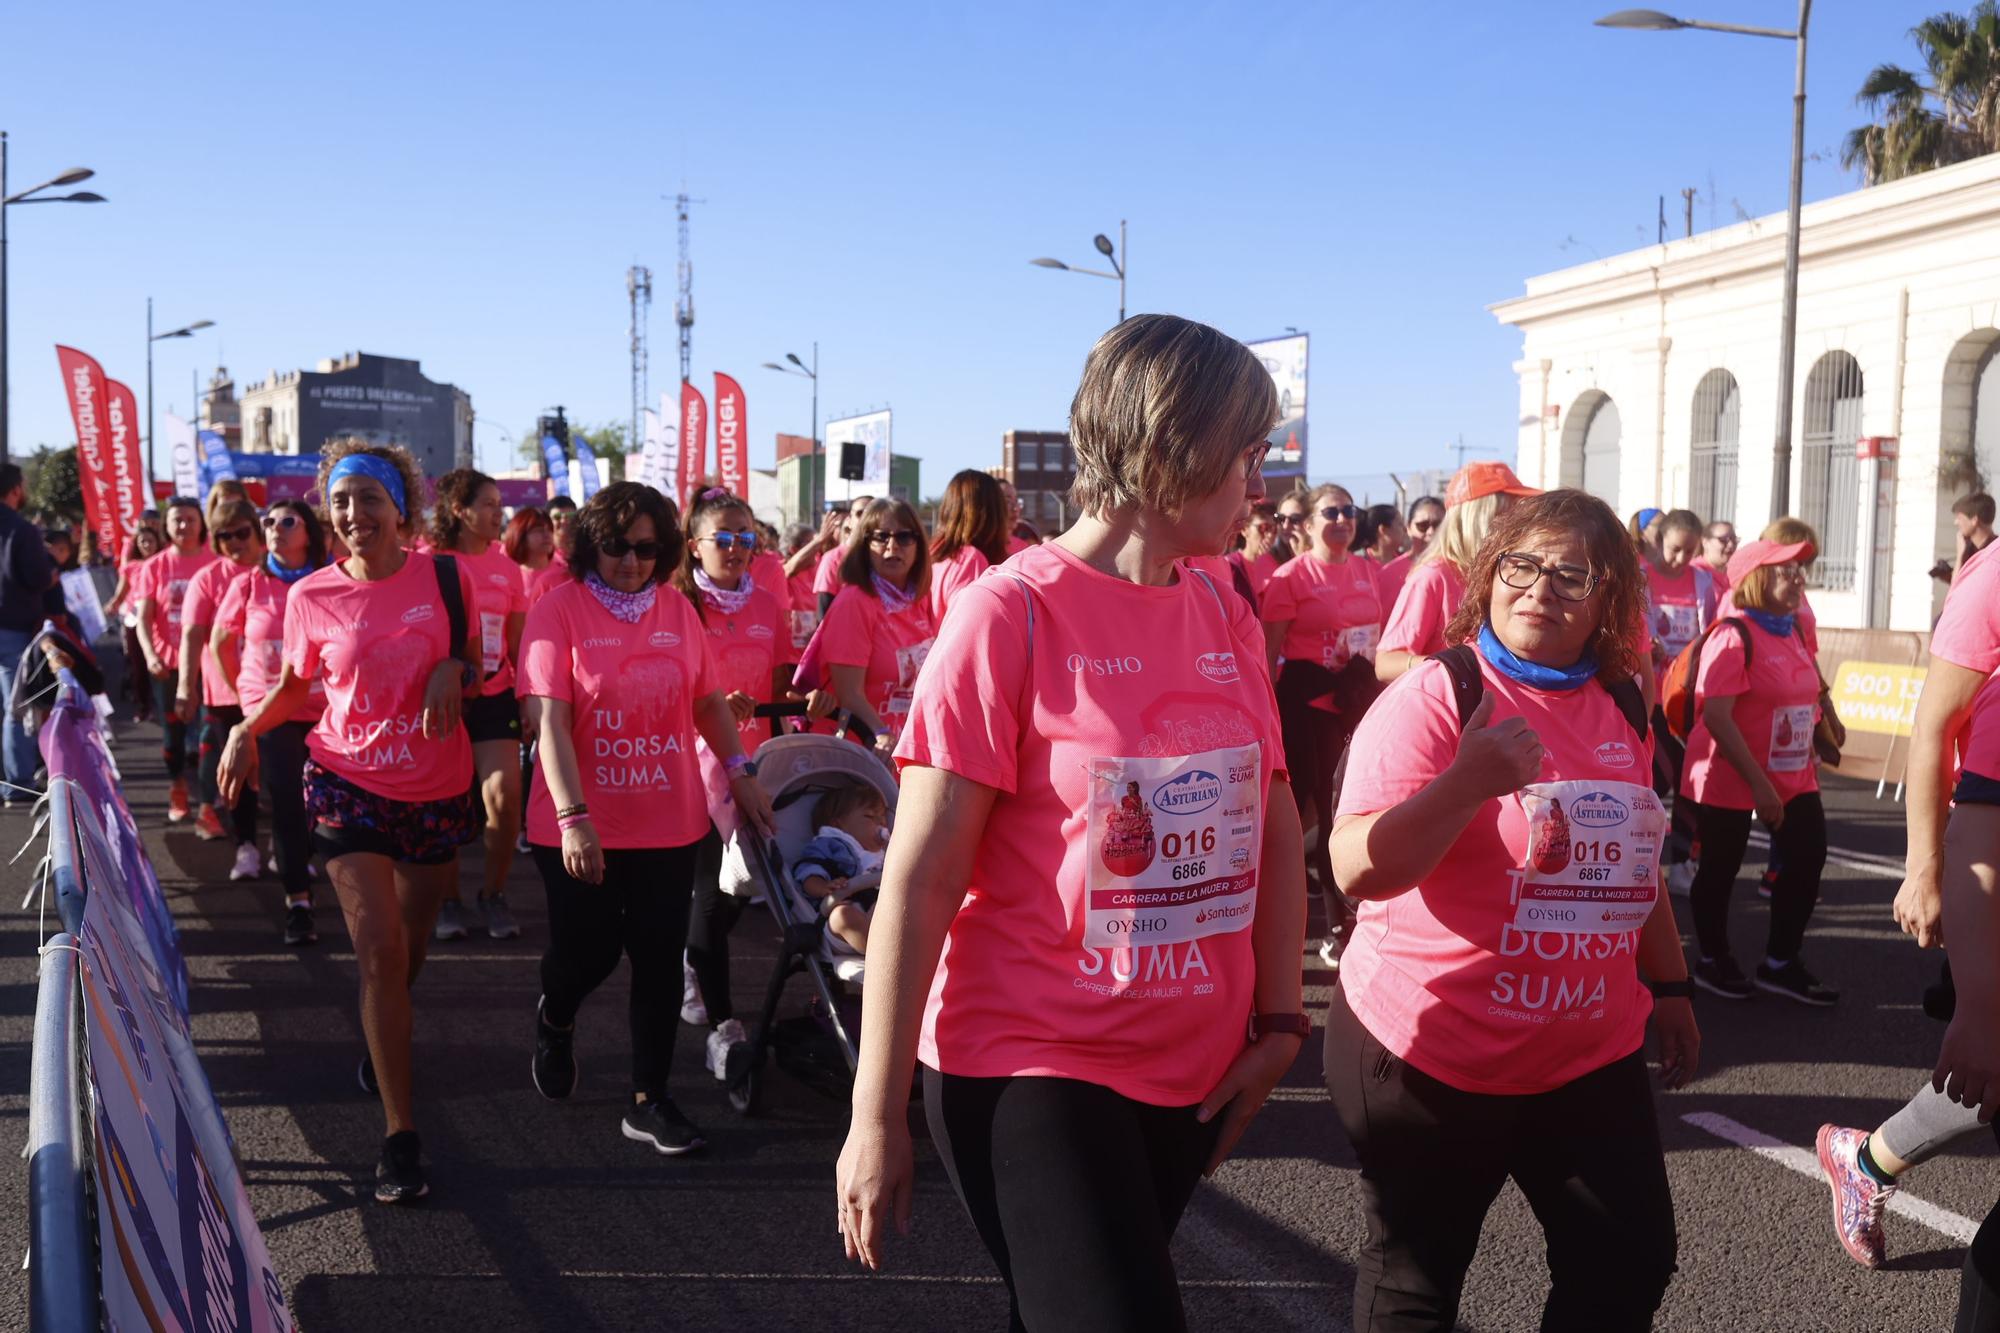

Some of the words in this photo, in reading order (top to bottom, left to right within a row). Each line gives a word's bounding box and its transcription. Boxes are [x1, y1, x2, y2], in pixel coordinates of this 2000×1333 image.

[1067, 653, 1142, 676] OYSHO
[1844, 671, 1892, 697] 900
[347, 711, 423, 743] DORSA
[593, 710, 622, 730] TU
[354, 743, 414, 765] UMA
[595, 764, 669, 786] SUMA
[1160, 788, 1219, 807] ASTURIANA
[1633, 802, 1656, 811] SUMA
[1574, 806, 1625, 820] ASTURIANA
[1161, 827, 1216, 859] 016
[1574, 841, 1621, 862] 016
[1172, 861, 1206, 880] 6866
[1579, 868, 1610, 880] 6867
[1112, 893, 1168, 904] CARRERA
[1170, 892, 1185, 902] DE
[1187, 889, 1198, 899] LA
[1200, 882, 1229, 896] MUJER
[1534, 888, 1574, 897] CARRERA
[1576, 890, 1590, 898] DE
[1592, 890, 1603, 898] LA
[1606, 891, 1631, 899] MUJER
[1207, 902, 1251, 920] Santander
[1528, 908, 1576, 922] OYSHO
[1611, 911, 1646, 921] Santander
[1106, 918, 1167, 934] OYSHO
[1078, 939, 1209, 982] SUMA
[1073, 978, 1121, 998] CARRERA
[1124, 988, 1138, 998] DE
[1139, 988, 1150, 998] LA
[1153, 986, 1182, 998] MUJER
[1193, 984, 1214, 995] 2023
[1490, 971, 1605, 1011] SUMA
[1488, 1006, 1530, 1022] CARRERA
[1533, 1014, 1546, 1024] DE
